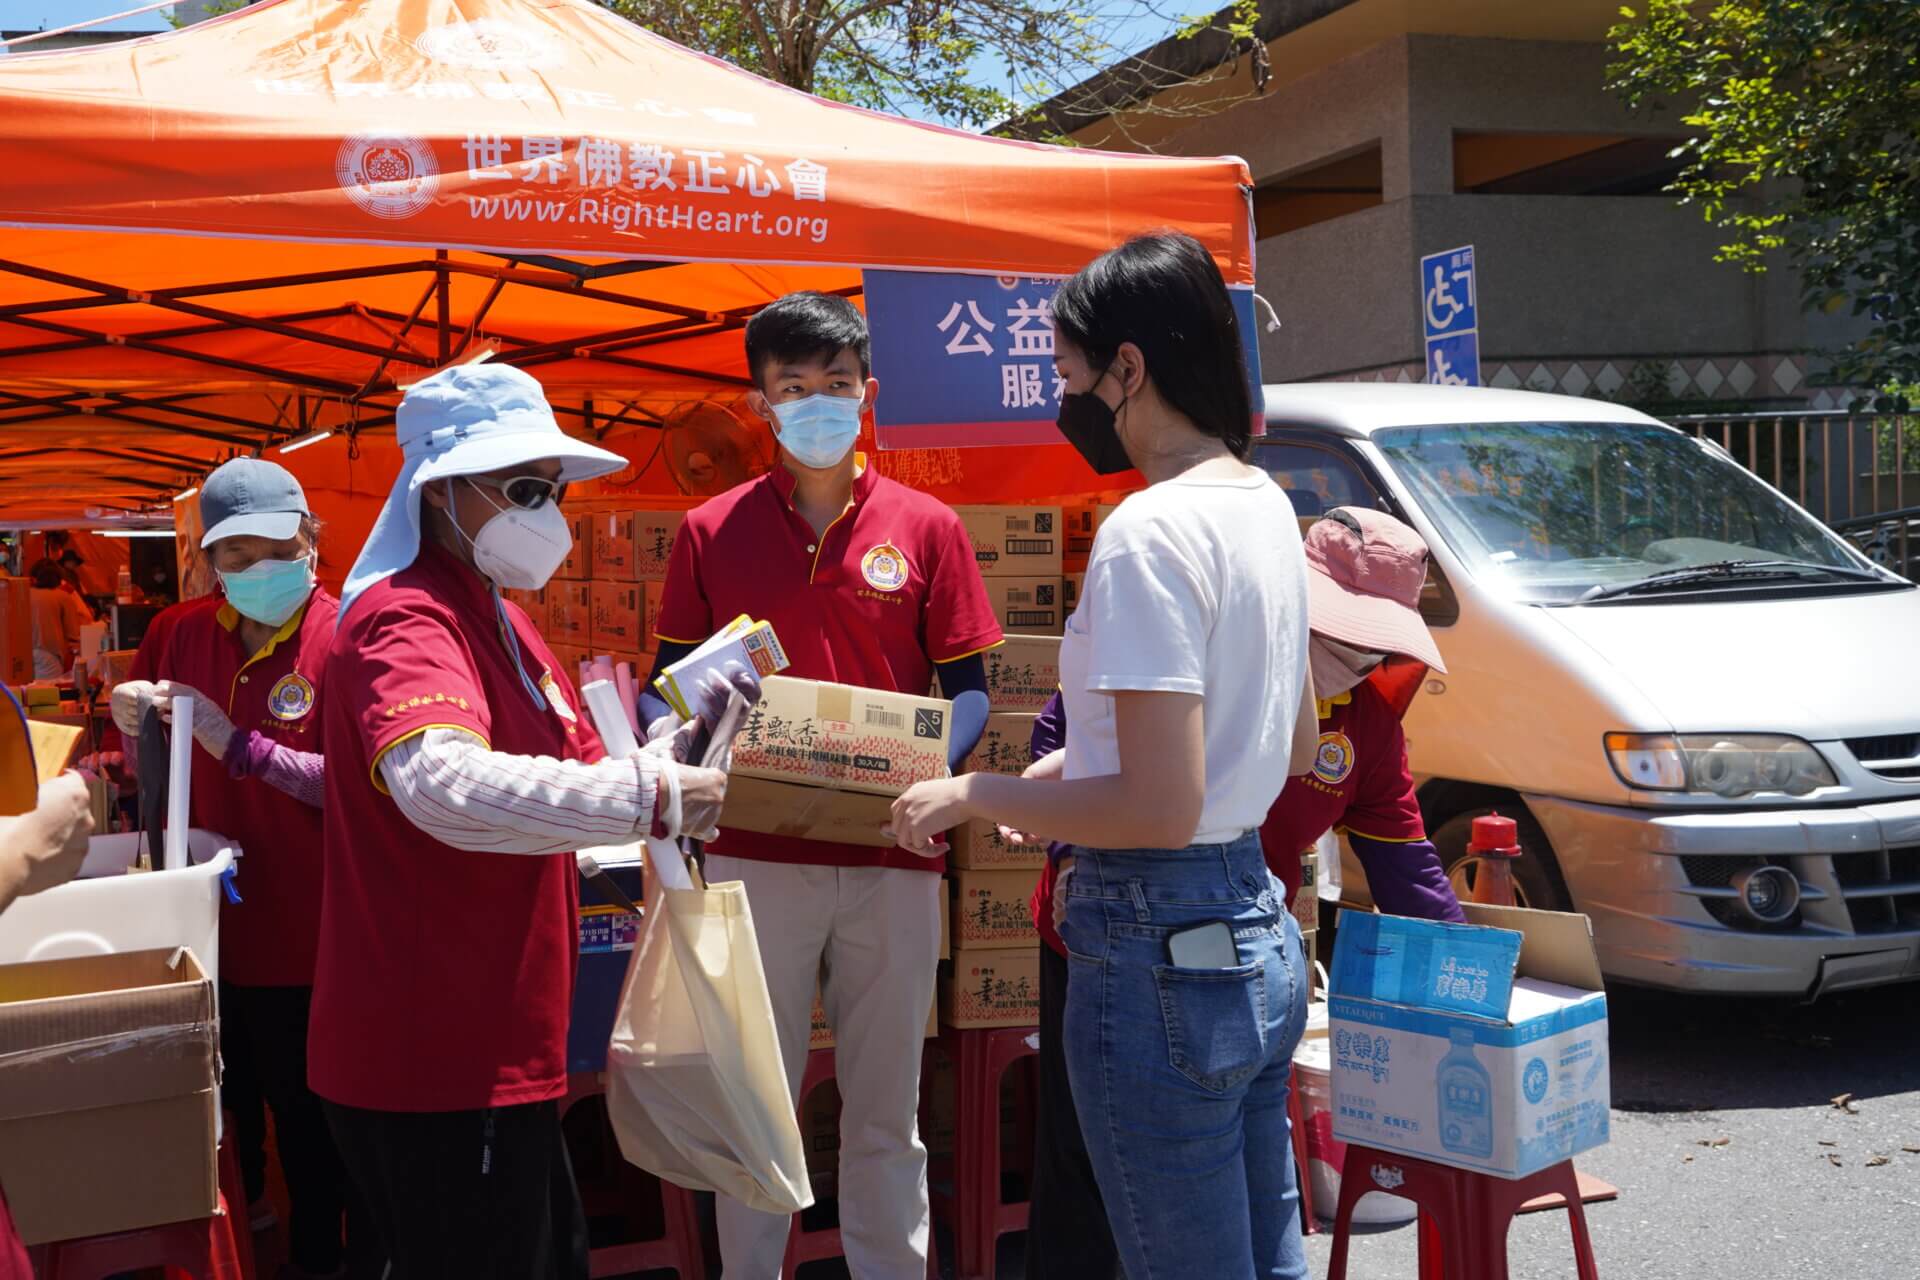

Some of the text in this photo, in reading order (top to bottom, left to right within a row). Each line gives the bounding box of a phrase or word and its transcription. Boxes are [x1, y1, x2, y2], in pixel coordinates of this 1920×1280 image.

[462, 131, 828, 202] 世界佛教正心會
[469, 196, 829, 243] www.RightHeart.org
[936, 297, 1055, 357] 公益
[741, 710, 818, 748] 素飄香
[916, 723, 926, 736] 6
[931, 712, 941, 726] 5
